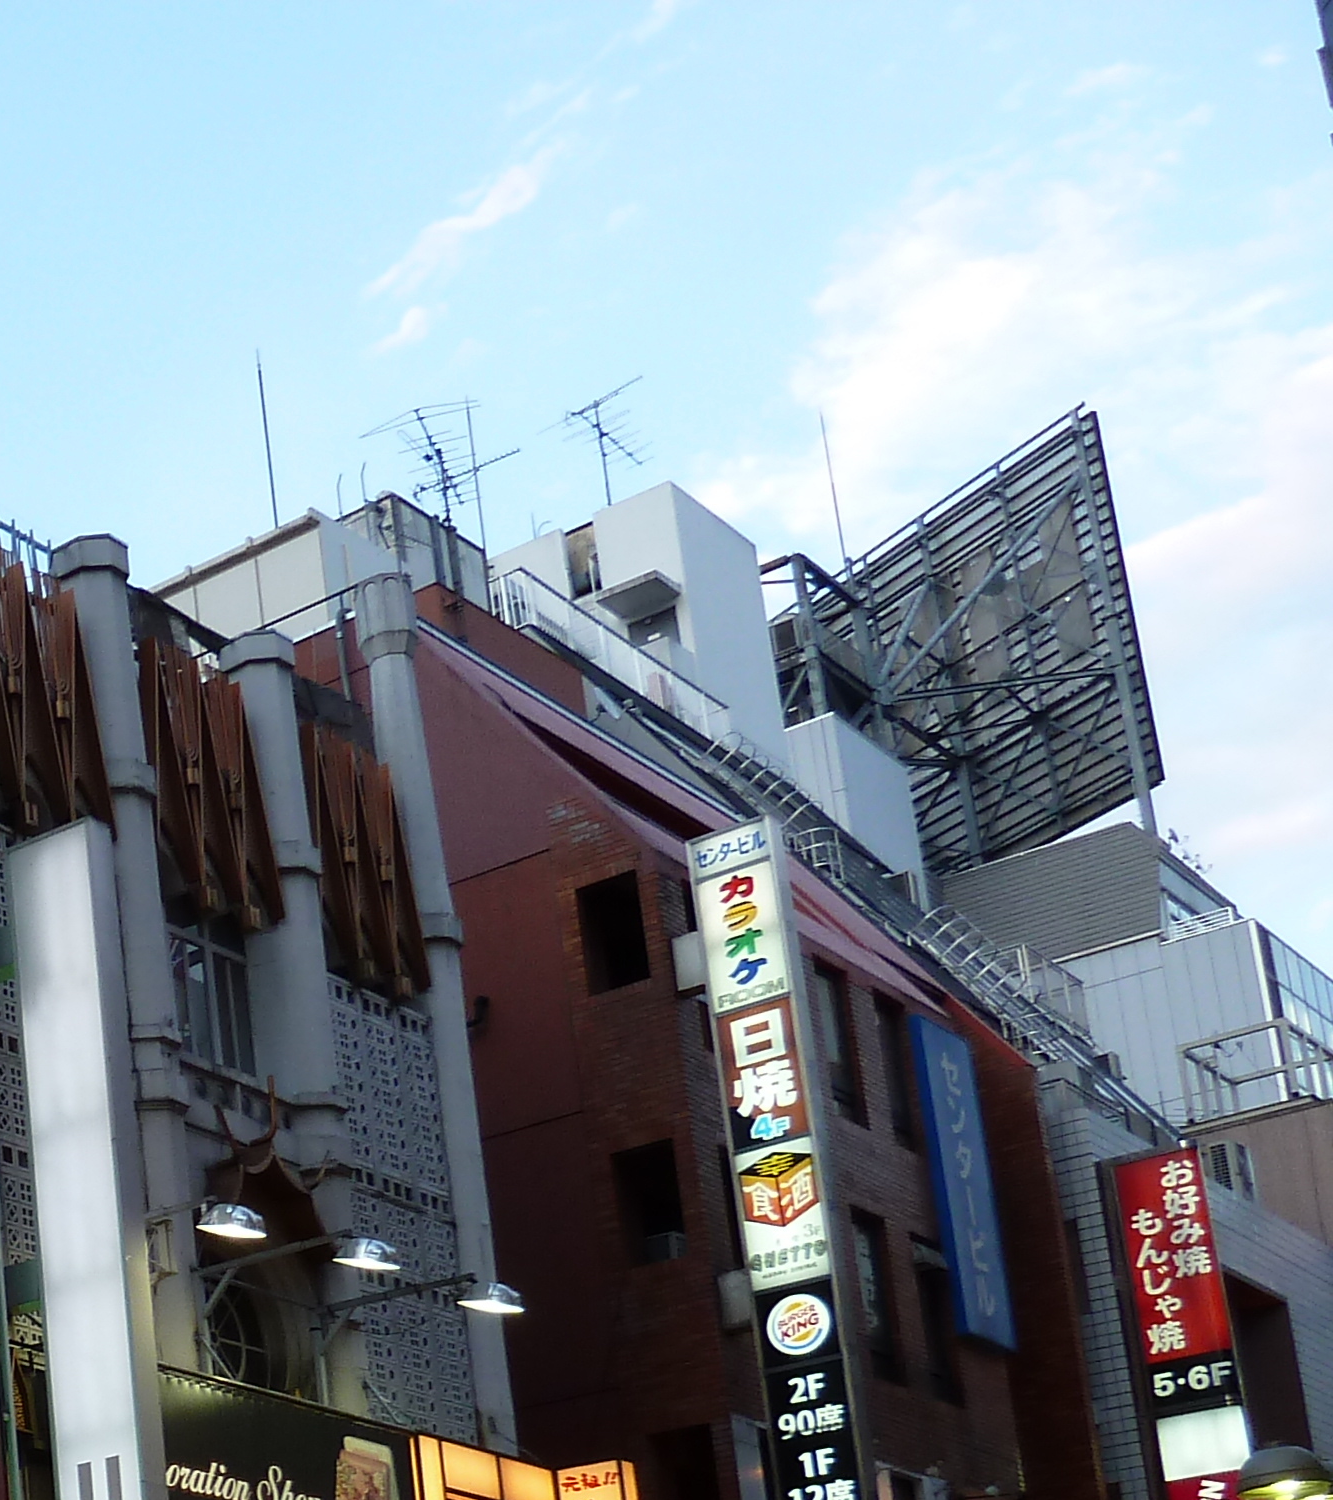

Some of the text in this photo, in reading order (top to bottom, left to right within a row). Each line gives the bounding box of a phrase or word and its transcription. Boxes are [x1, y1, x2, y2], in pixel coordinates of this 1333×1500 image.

[695, 826, 767, 868] センタービル
[719, 873, 769, 986] カラオケ
[730, 1007, 798, 1117] 日焼
[749, 1113, 792, 1141] 4F
[1160, 1159, 1212, 1278] お好み焼
[1131, 1207, 1186, 1356] もんじゃ焼
[779, 1312, 820, 1343] KING
[787, 1372, 827, 1405] 2F
[777, 1402, 847, 1441] 90席
[796, 1447, 838, 1480] 1F
